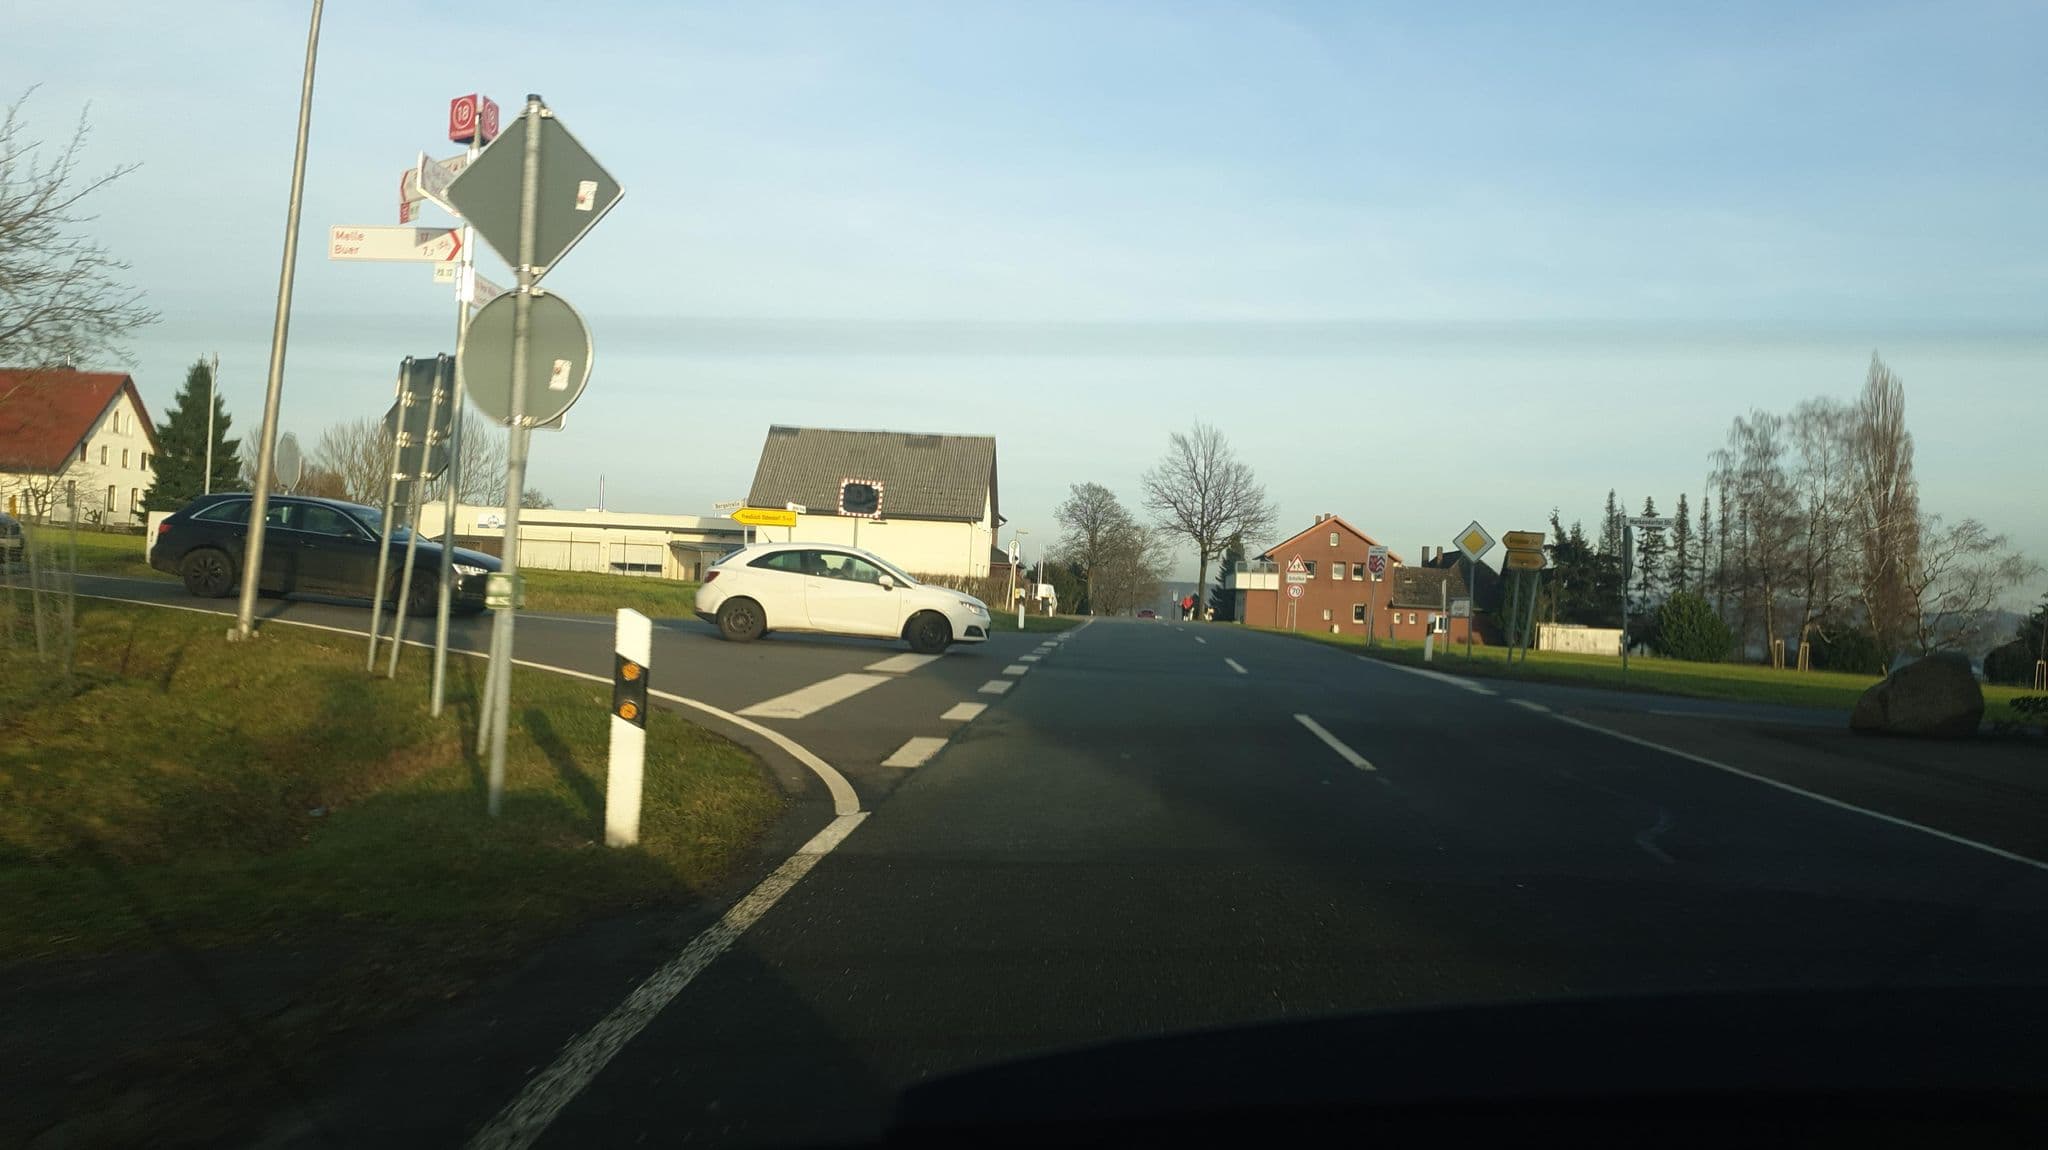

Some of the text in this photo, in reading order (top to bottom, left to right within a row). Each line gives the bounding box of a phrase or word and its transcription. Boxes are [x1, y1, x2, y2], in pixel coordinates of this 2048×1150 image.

[457, 105, 469, 122] 18
[334, 231, 365, 241] Melle
[334, 245, 359, 256] Buer
[1292, 588, 1301, 596] 70
